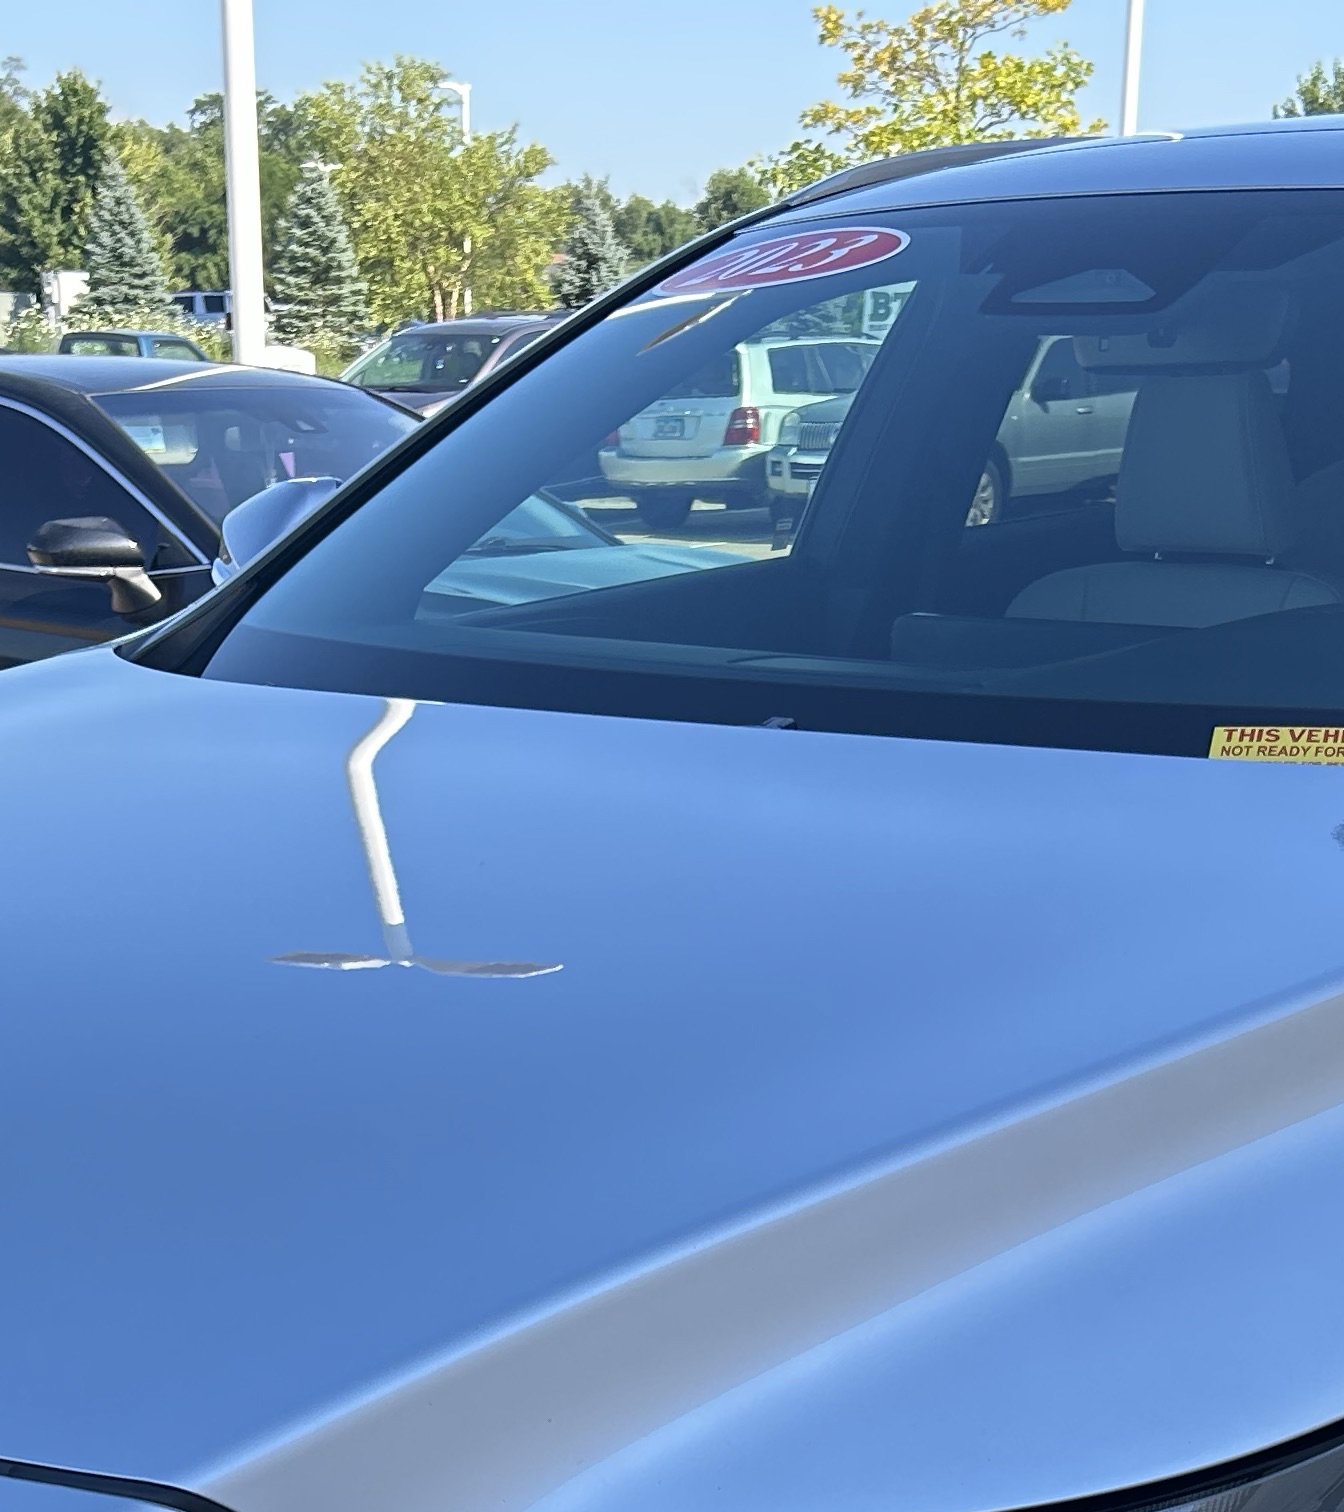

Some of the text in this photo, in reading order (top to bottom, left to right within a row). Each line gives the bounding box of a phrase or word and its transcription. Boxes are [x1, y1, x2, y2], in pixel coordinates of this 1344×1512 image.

[674, 234, 879, 289] 2023
[1223, 728, 1281, 743] THIS
[1220, 745, 1253, 757] NOT
[1256, 745, 1312, 757] READY
